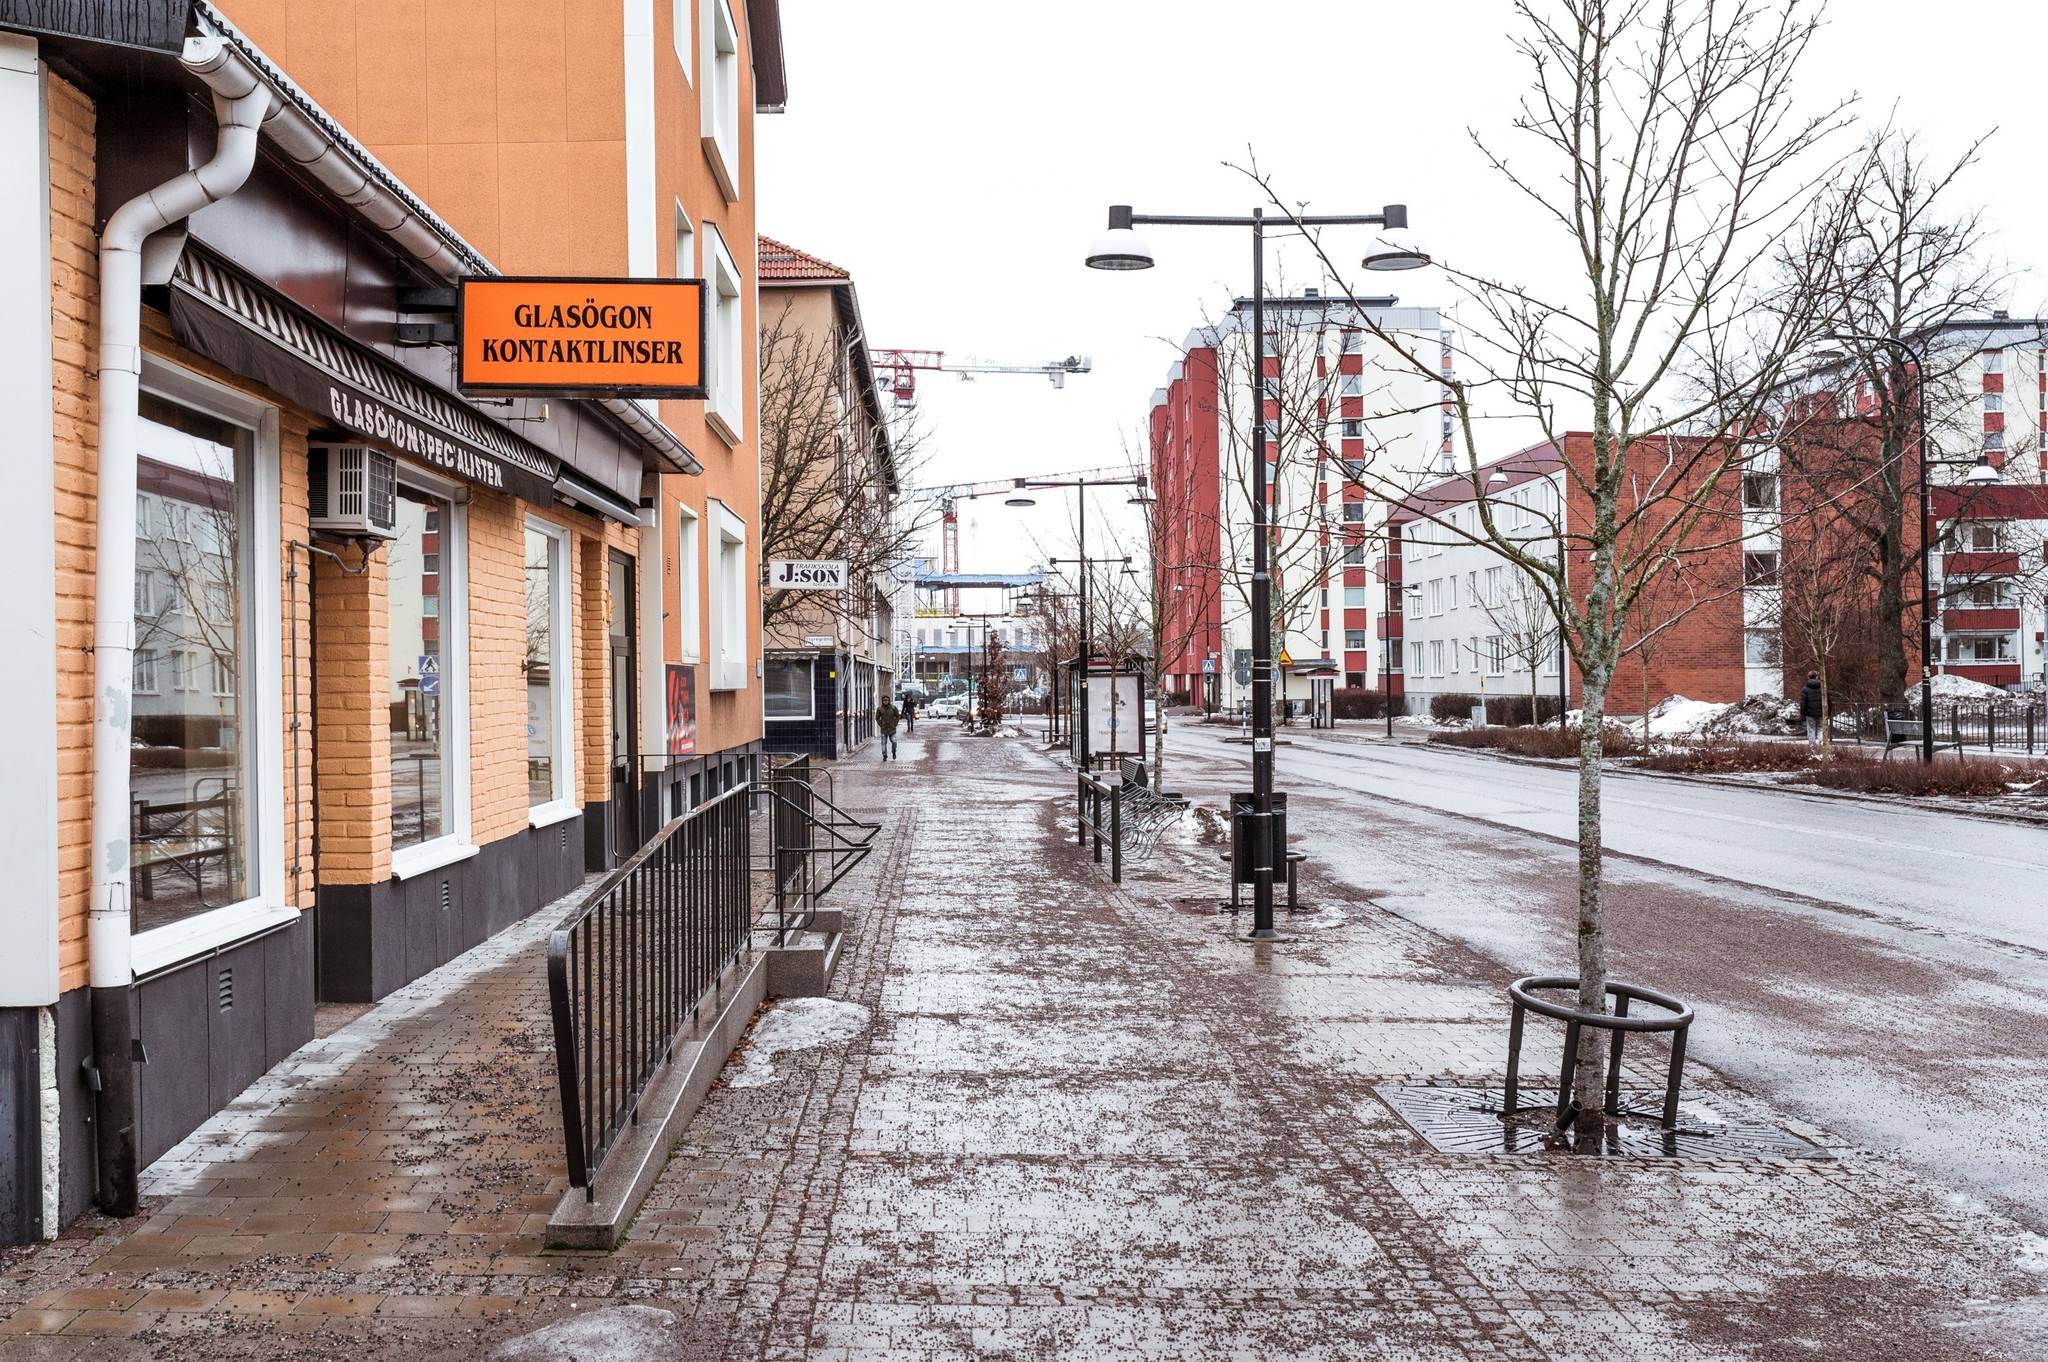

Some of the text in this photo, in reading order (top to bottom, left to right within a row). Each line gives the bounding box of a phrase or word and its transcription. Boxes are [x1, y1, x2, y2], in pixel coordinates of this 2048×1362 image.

[514, 298, 653, 329] GLASÖGON
[482, 338, 684, 364] KONTAKTLINSER
[778, 563, 840, 583] J:SON
